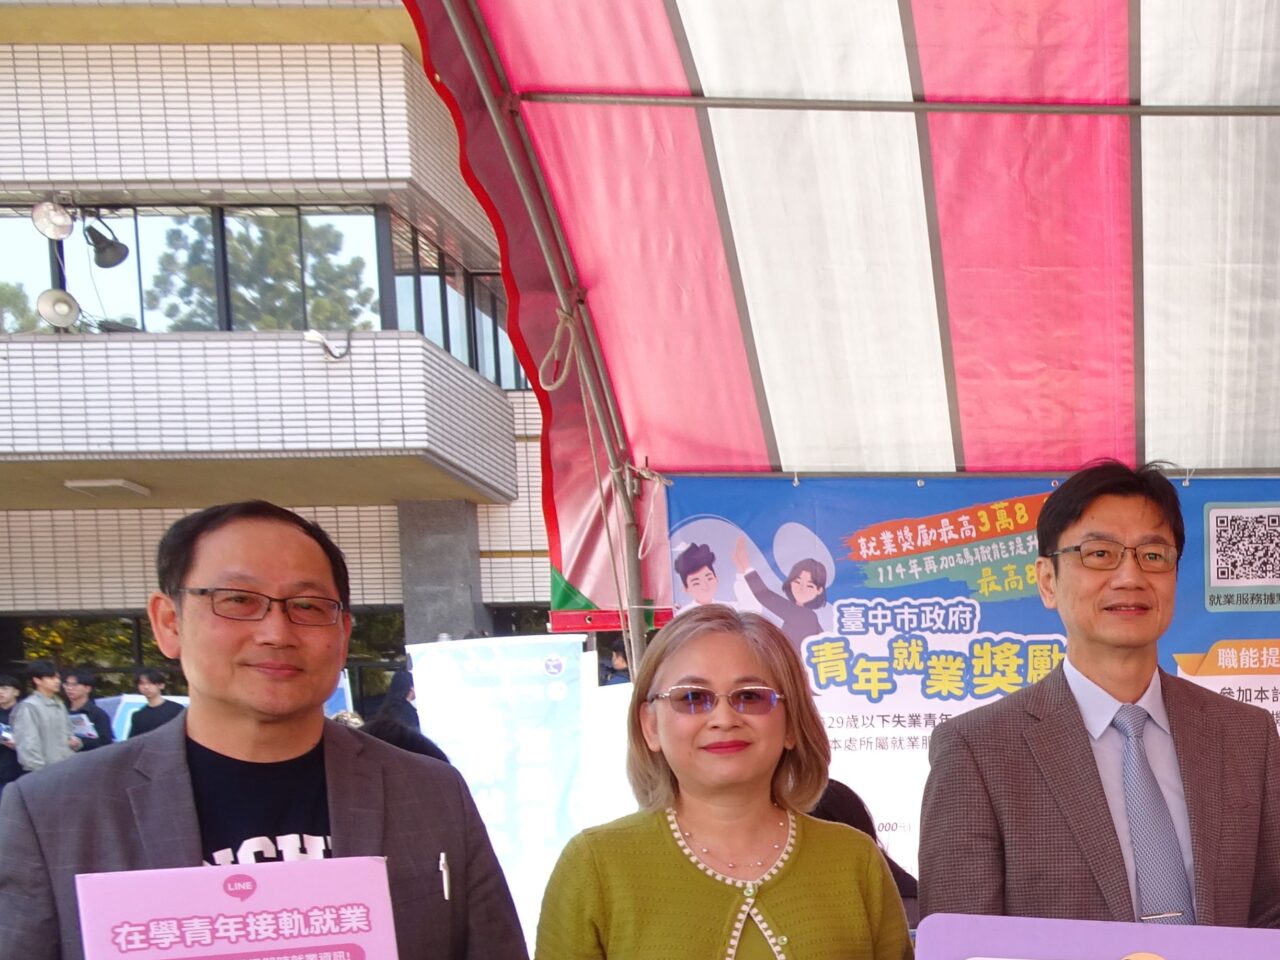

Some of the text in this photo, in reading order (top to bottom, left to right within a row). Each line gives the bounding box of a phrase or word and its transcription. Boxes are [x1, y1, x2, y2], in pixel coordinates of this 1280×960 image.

[838, 604, 974, 633] 臺中市政府
[227, 881, 253, 892] LINE
[113, 906, 370, 951] 在學青年接軌就業
